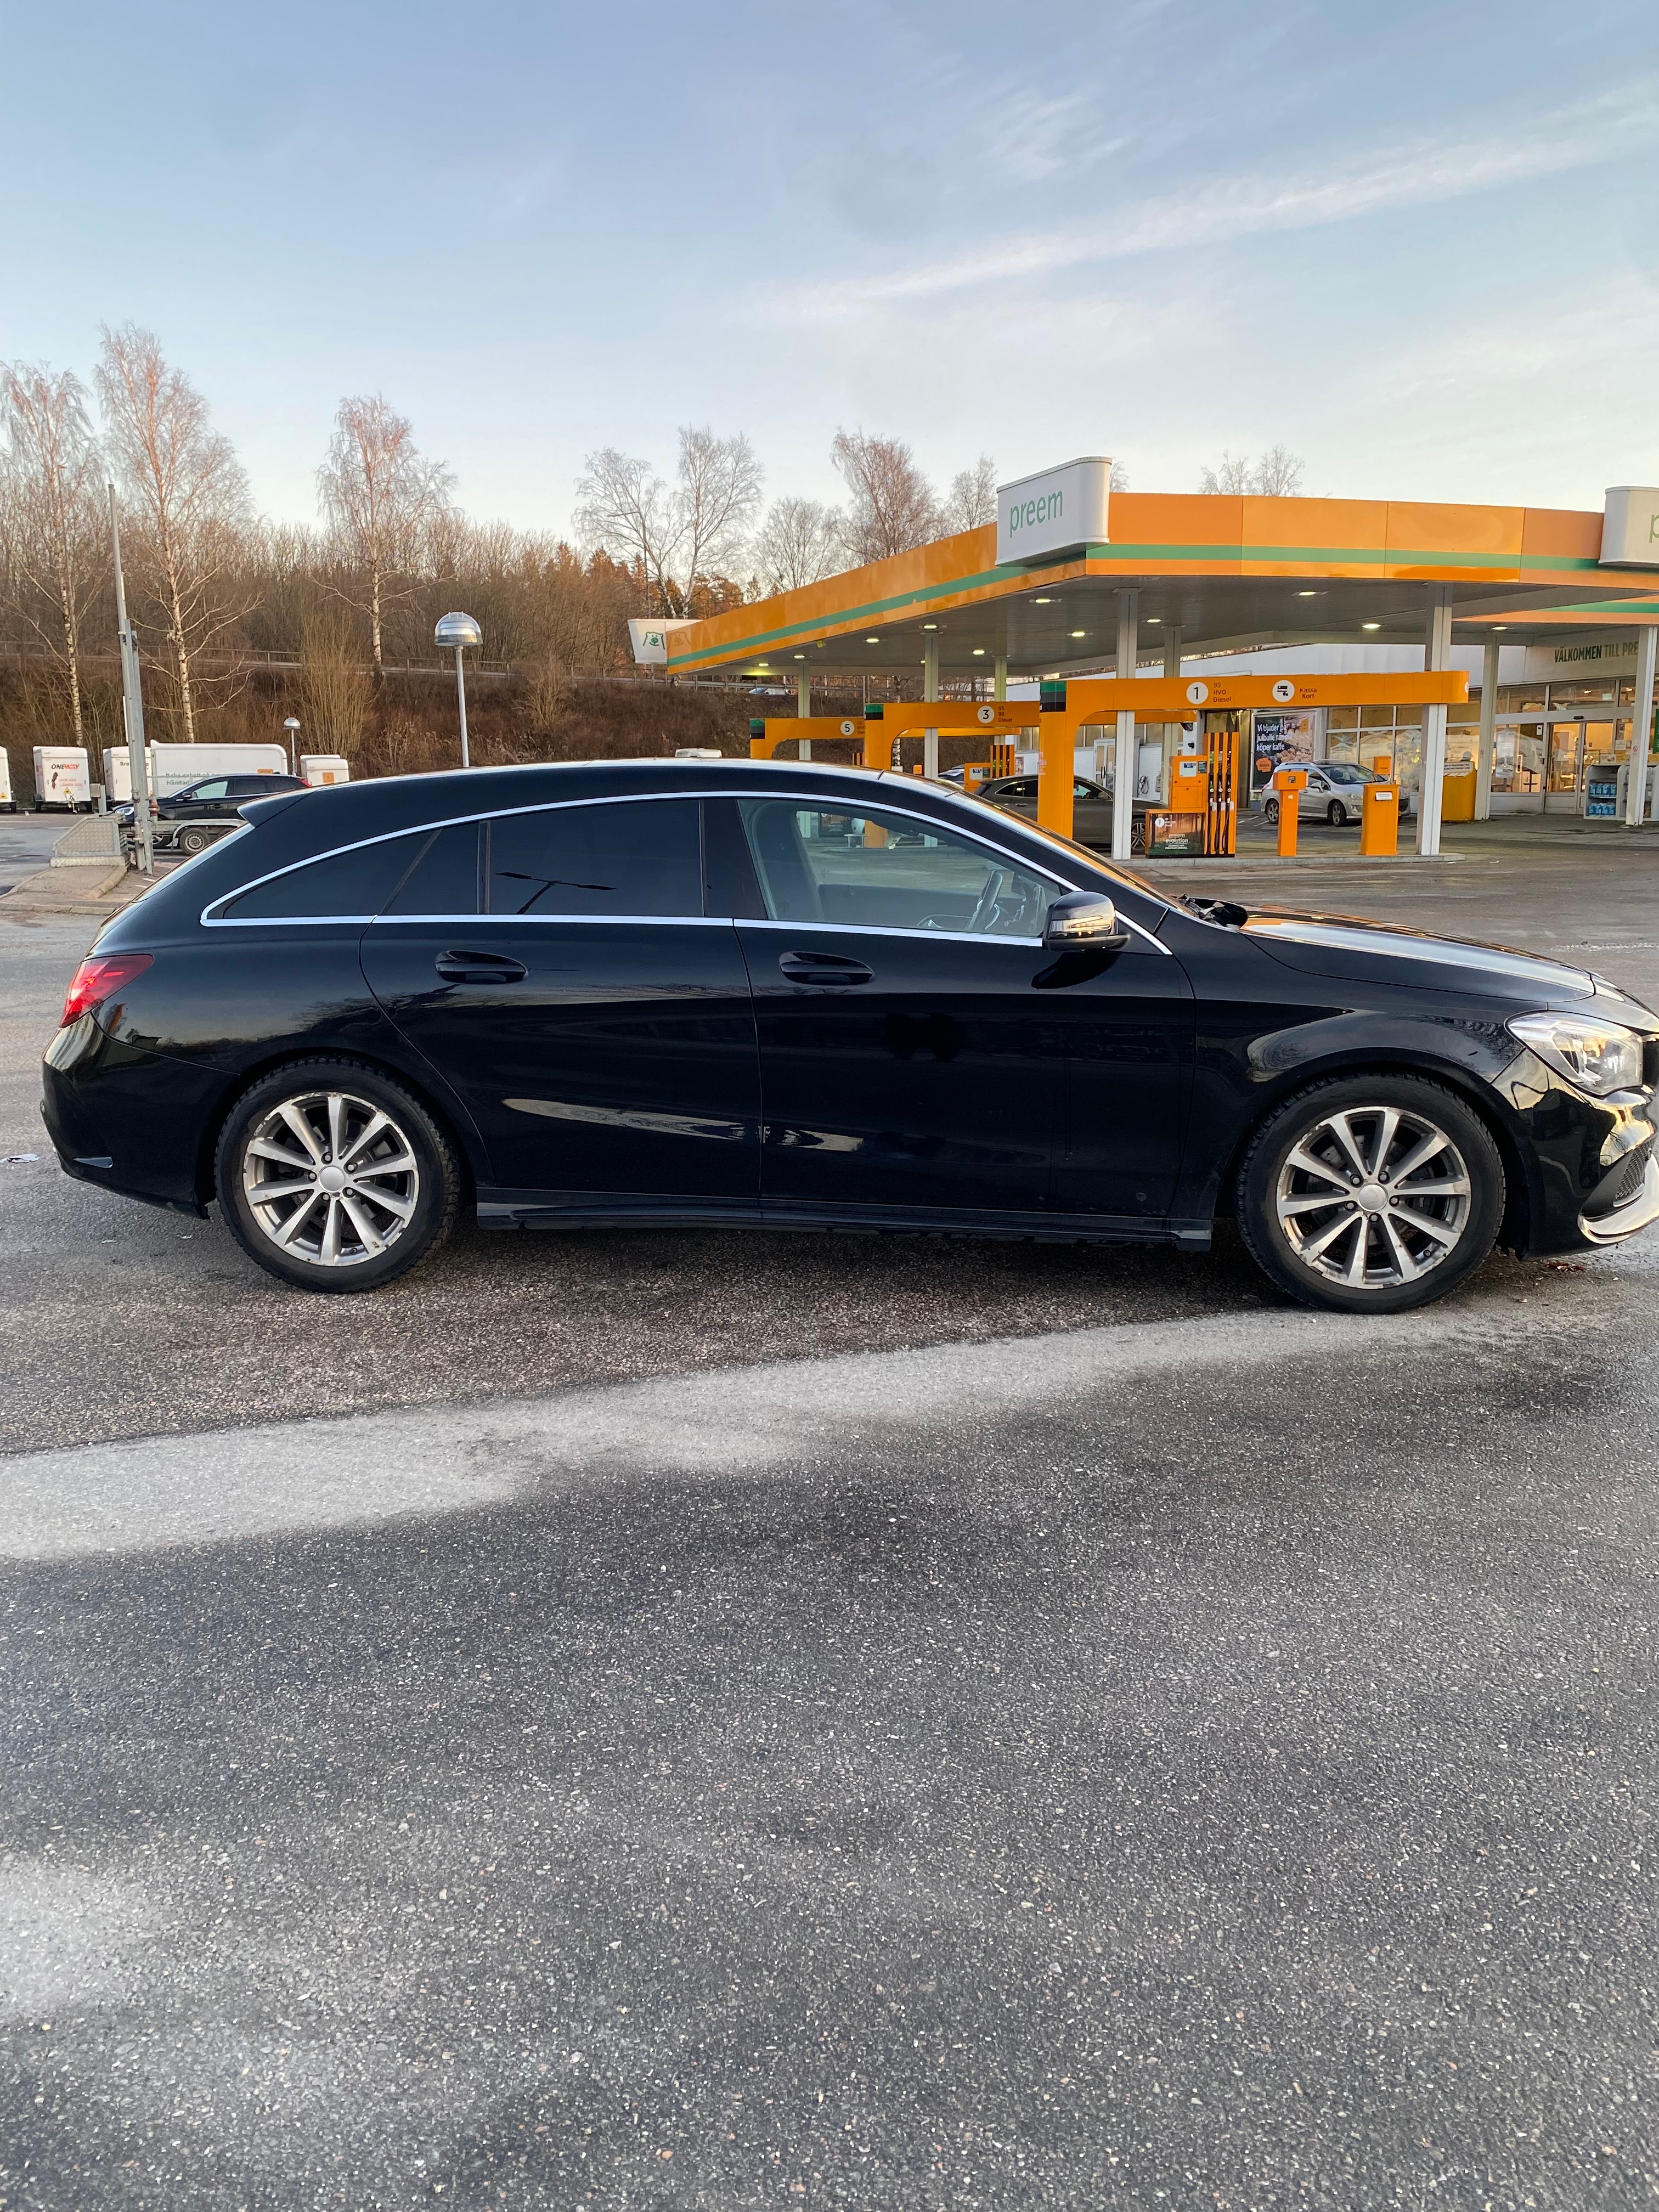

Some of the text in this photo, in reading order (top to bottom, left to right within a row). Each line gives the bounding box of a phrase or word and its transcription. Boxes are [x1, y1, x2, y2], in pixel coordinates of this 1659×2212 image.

[1010, 490, 1063, 538] preem
[1555, 645, 1602, 663] VÄLKOMMEN
[1604, 643, 1620, 658] TILL
[1194, 686, 1199, 699] 1
[983, 709, 989, 720] 3
[845, 724, 850, 732] 5
[1263, 724, 1279, 733] bjuder
[1256, 733, 1275, 743] julbulle
[1256, 742, 1285, 753] köper kaffe
